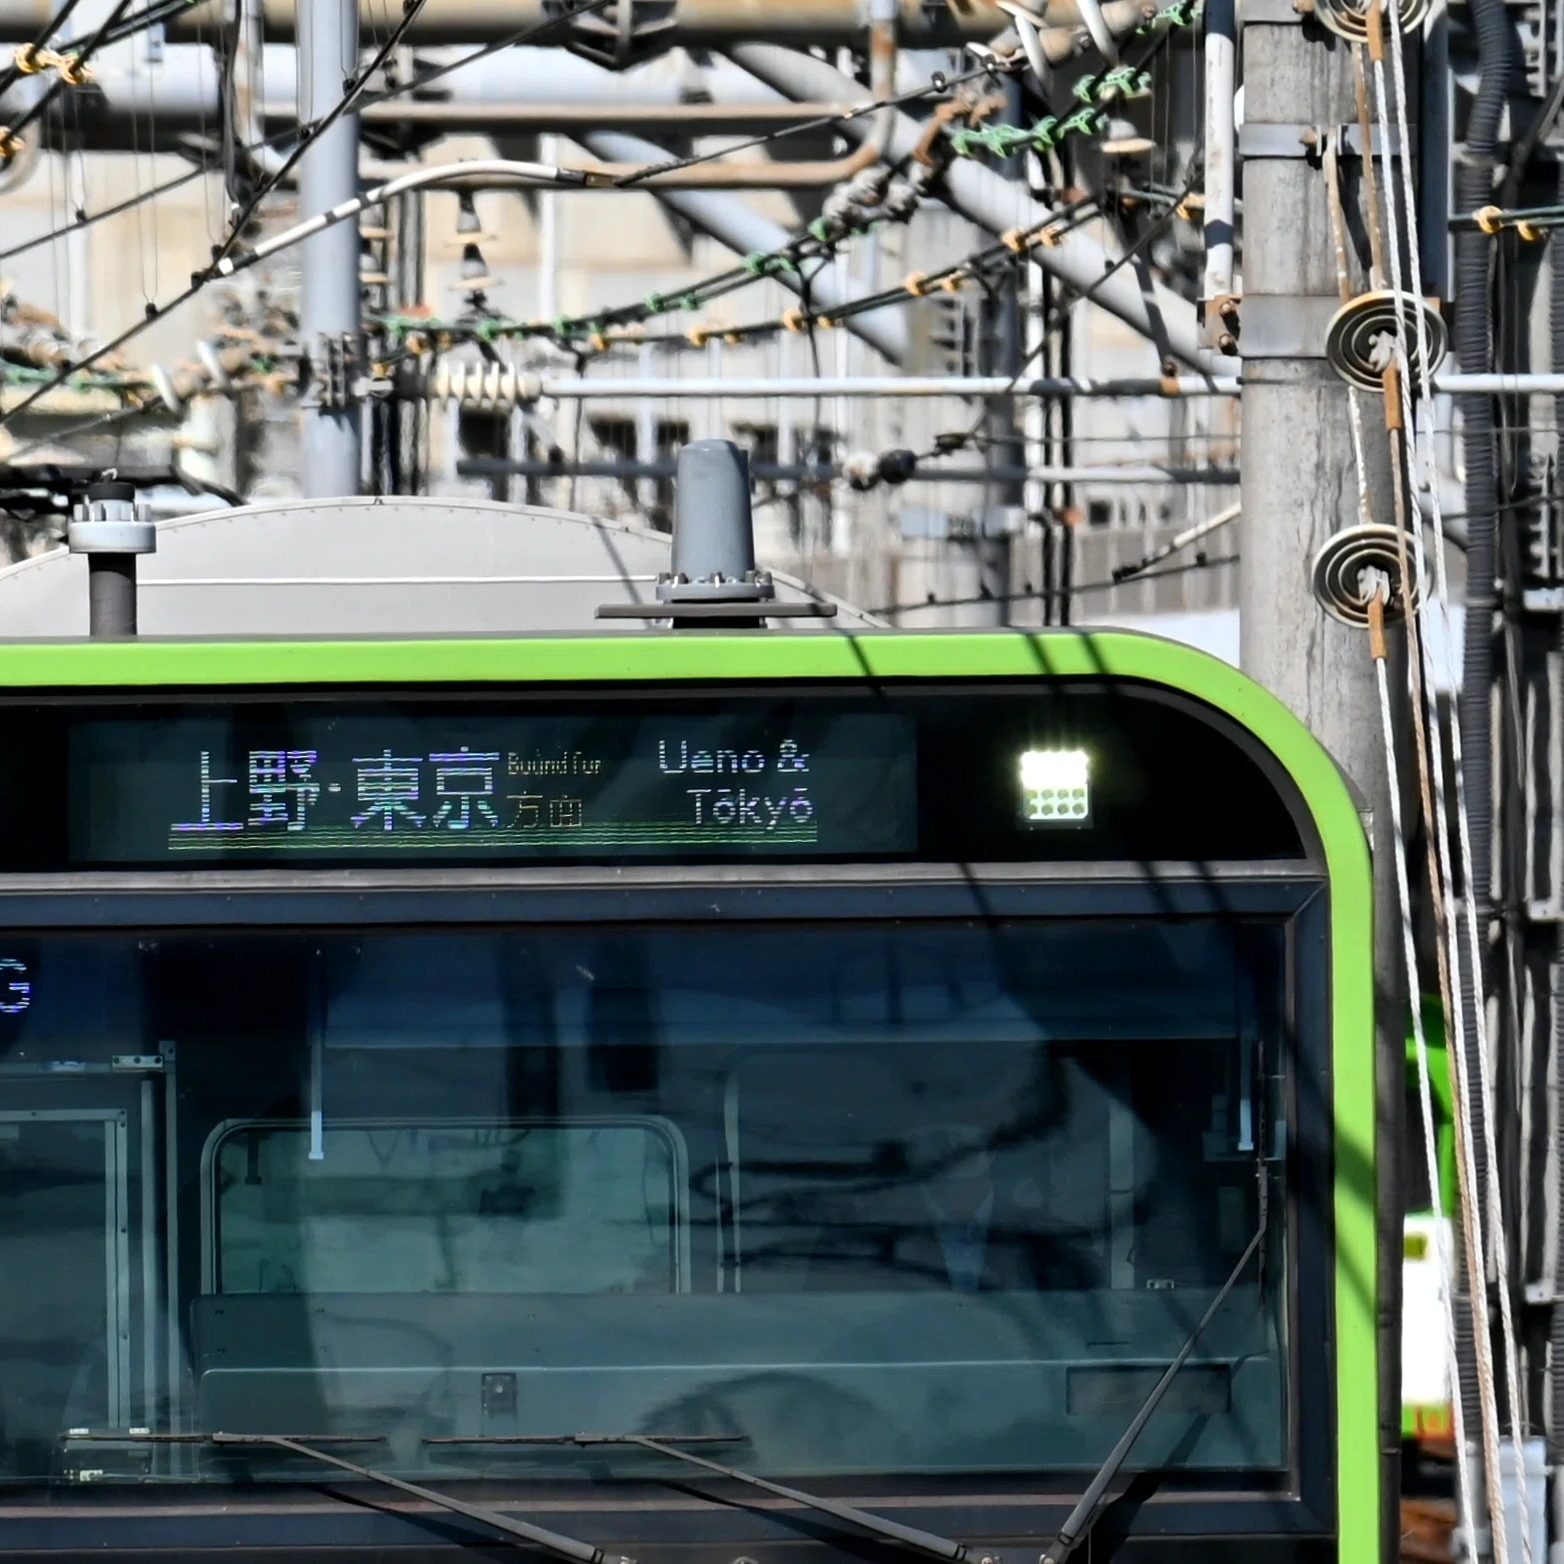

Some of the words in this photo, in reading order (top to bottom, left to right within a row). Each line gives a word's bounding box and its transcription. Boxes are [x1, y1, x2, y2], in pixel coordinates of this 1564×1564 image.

[659, 740, 765, 774] Ueno
[777, 739, 810, 773] &
[686, 788, 813, 831] Tōkyō
